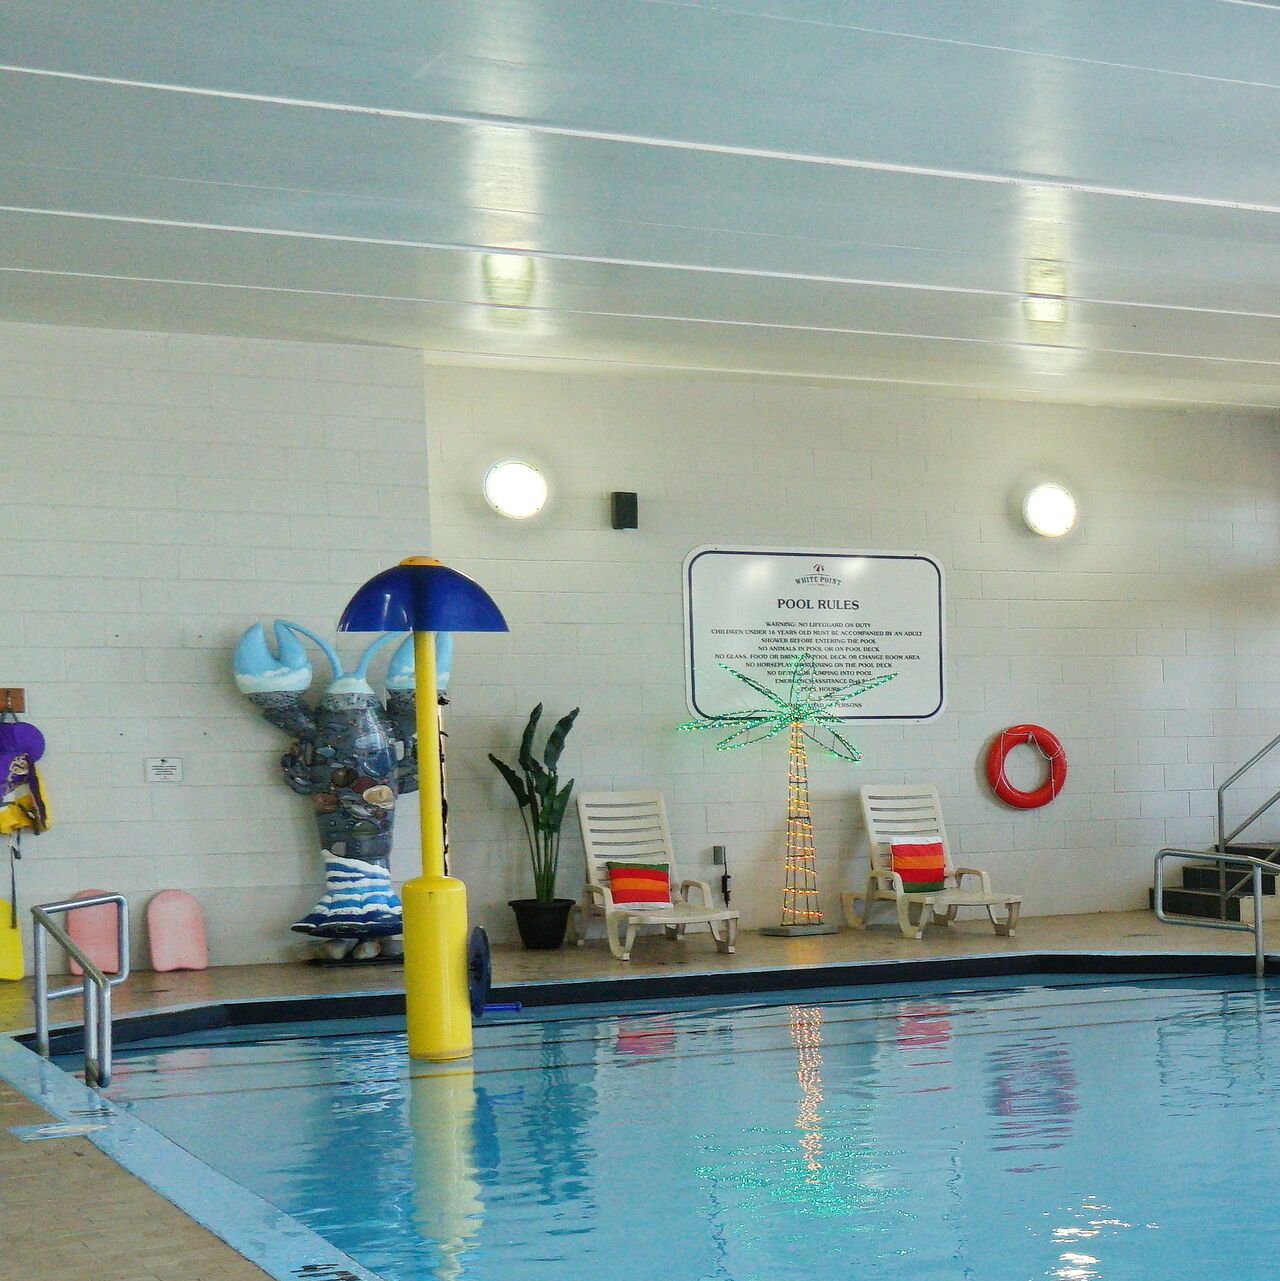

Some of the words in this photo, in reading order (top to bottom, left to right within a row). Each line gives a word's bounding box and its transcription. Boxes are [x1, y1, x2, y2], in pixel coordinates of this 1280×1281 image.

[794, 576, 818, 585] WHITE
[820, 577, 843, 586] POINT
[777, 598, 814, 610] POOL
[818, 599, 860, 611] RULES
